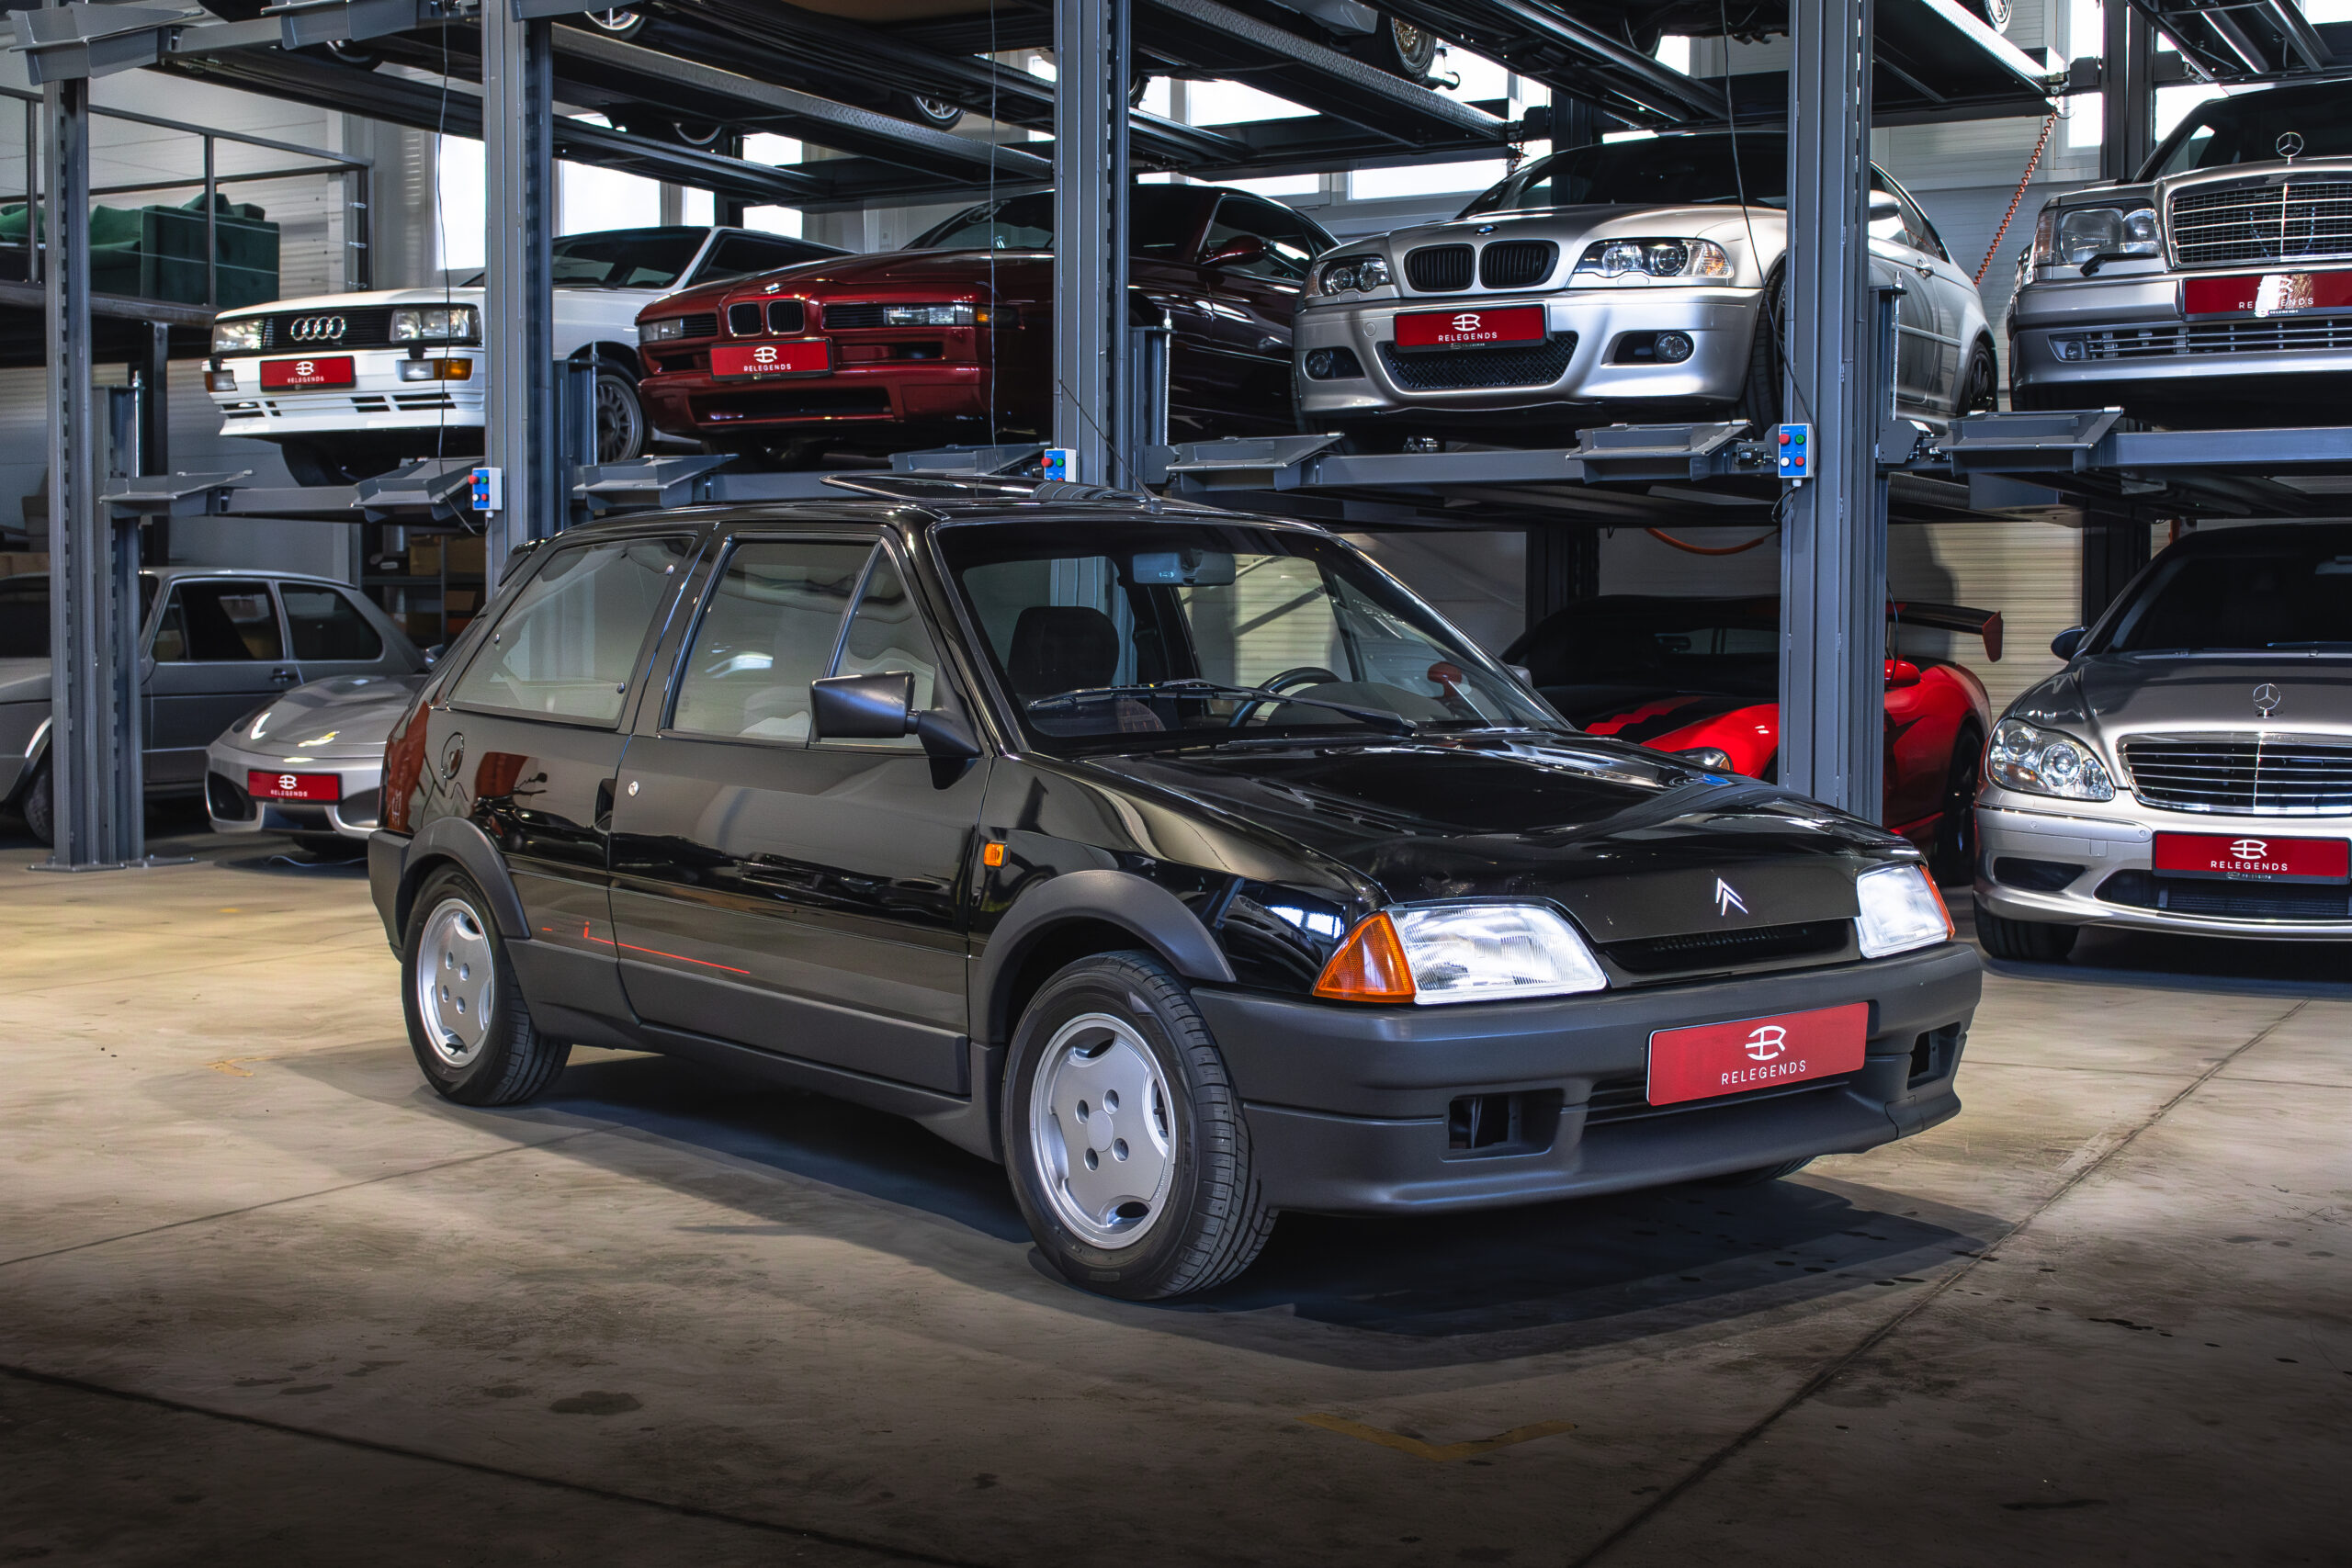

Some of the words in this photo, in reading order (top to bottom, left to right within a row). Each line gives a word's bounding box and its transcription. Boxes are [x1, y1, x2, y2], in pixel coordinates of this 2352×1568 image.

[2238, 297, 2314, 310] REENDS
[1438, 332, 1498, 342] RELEGENDS
[743, 363, 792, 372] RELEGENDS
[2211, 860, 2289, 871] RELEGENDS
[1721, 1059, 1807, 1086] RELEGENDS
